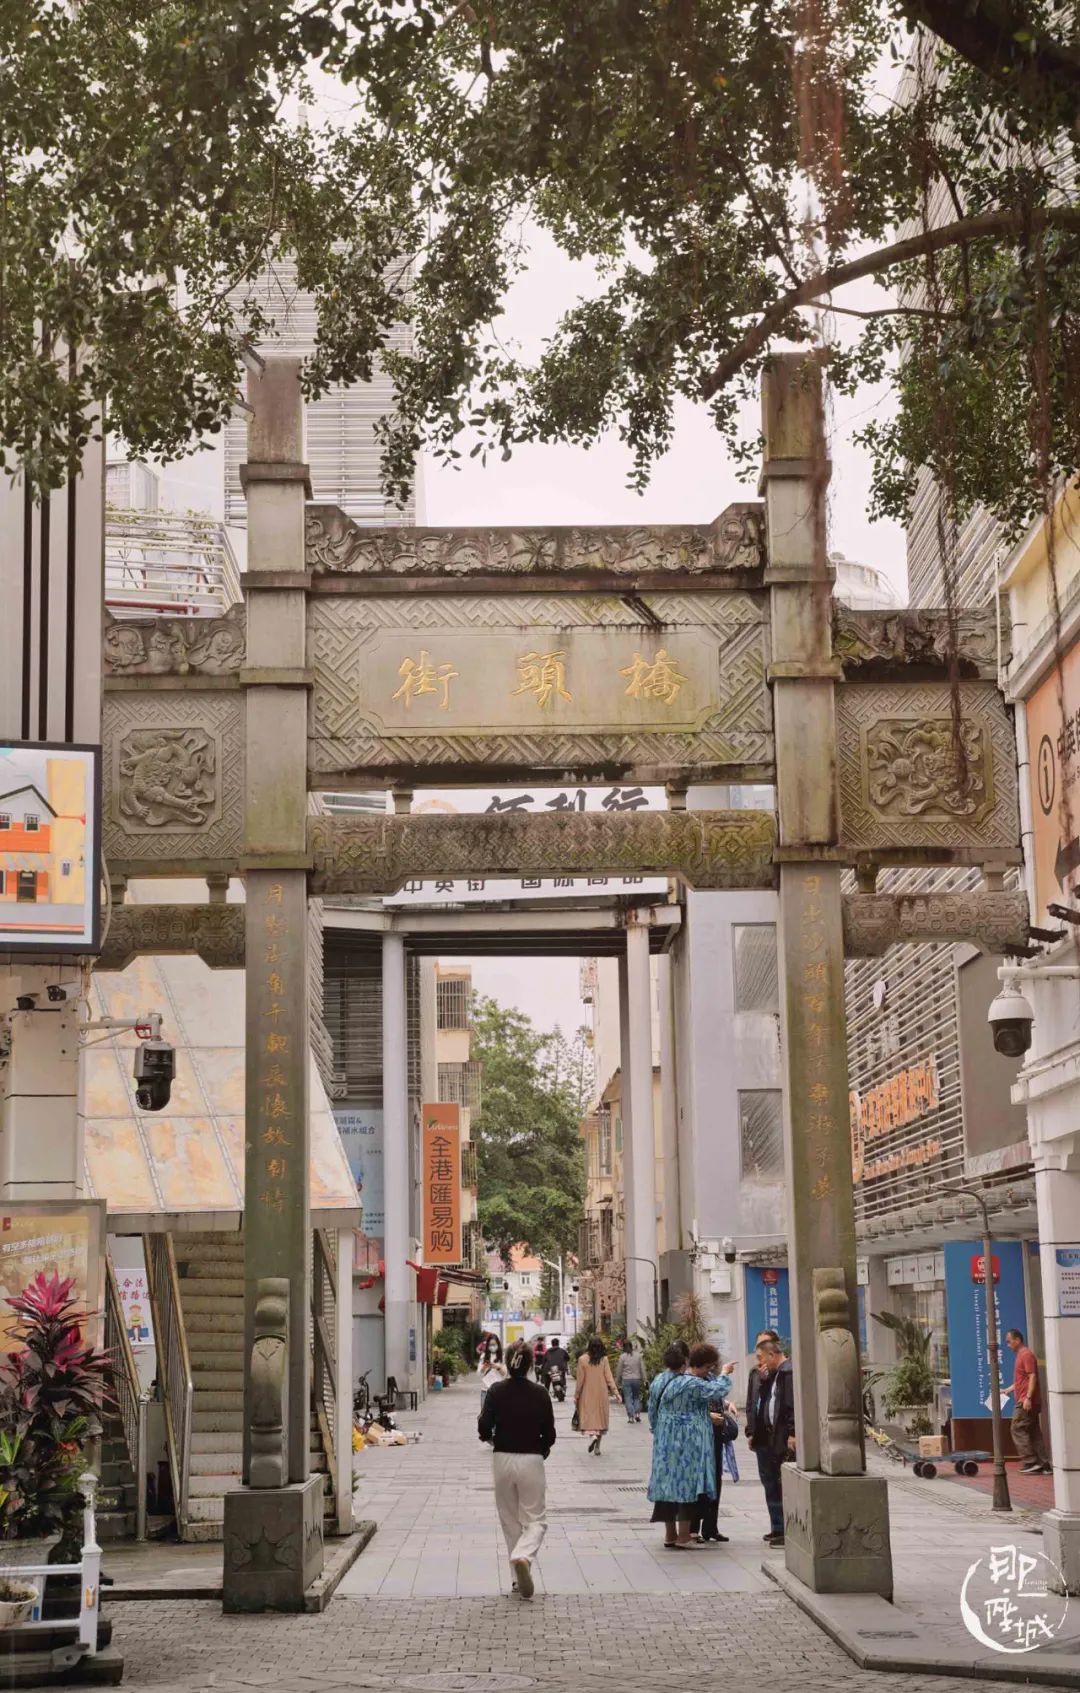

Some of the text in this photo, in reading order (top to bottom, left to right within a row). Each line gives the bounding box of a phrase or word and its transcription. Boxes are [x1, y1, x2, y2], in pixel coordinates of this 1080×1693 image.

[430, 1135, 453, 1252] 全港匯易购
